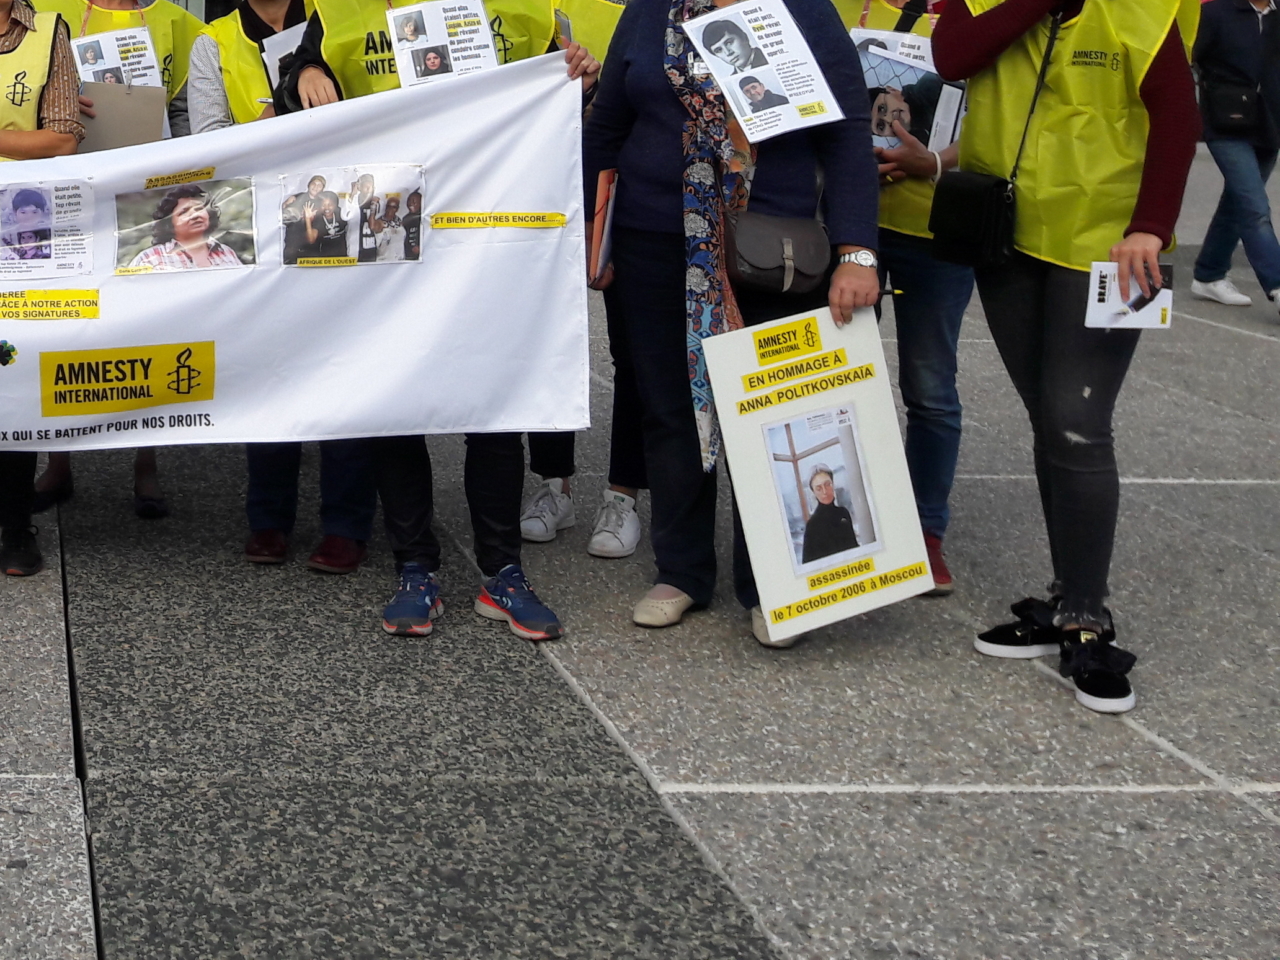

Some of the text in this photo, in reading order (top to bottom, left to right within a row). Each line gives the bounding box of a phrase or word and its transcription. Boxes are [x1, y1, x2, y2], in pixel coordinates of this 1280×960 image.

[1072, 50, 1108, 61] AMNESTY
[365, 57, 397, 76] INTE
[434, 217, 445, 225] ET
[446, 216, 466, 224] BIEN
[468, 215, 510, 224] D'AUTRES
[332, 258, 356, 266] L'OUEST
[30, 299, 62, 309] NOTRE
[63, 299, 98, 308] ACTION
[1, 310, 20, 319] VOS
[22, 310, 81, 319] SIGNATURES
[758, 329, 798, 351] AMNESTY
[759, 343, 801, 360] INTERNATIONAL
[53, 357, 153, 386] AMNESTY
[748, 350, 843, 389] EN HOMMAGE À
[54, 385, 154, 405] INTERNATIONAL
[738, 365, 874, 416] ANNA POLITKOVSKAÏA
[12, 429, 33, 441] QUI
[36, 429, 51, 440] SE
[55, 423, 103, 439] BATTENT
[107, 418, 138, 433] POUR
[141, 415, 165, 429] NOS
[169, 413, 215, 428] DROITS.
[809, 559, 871, 588] assassinée
[773, 564, 923, 622] le 7 octobre 2006 à Moscou
